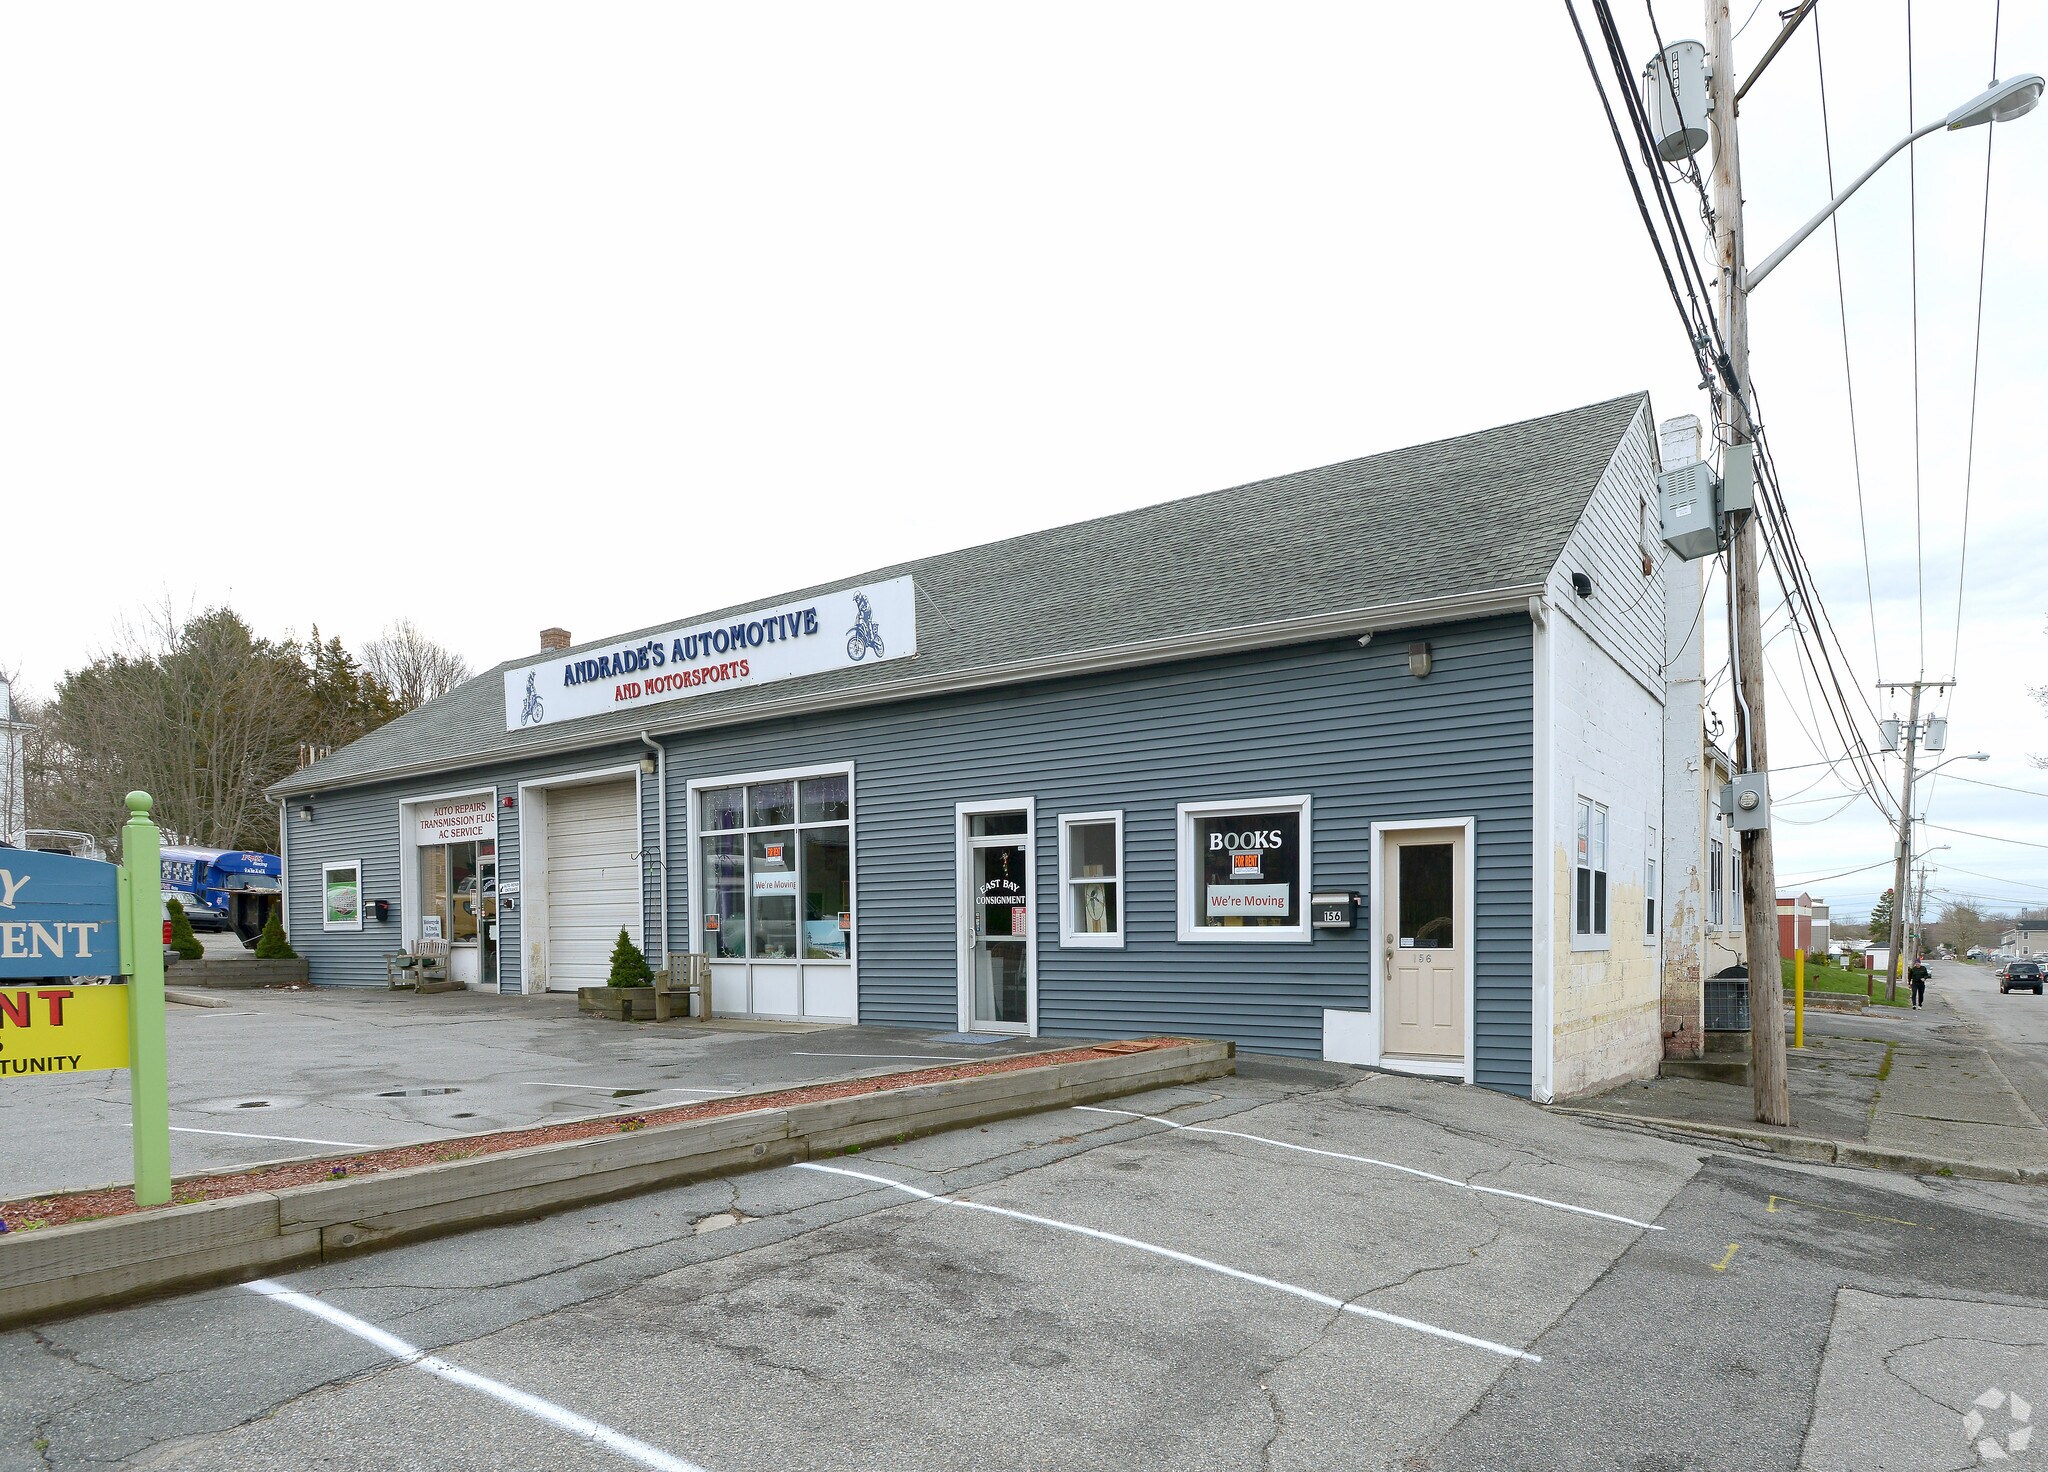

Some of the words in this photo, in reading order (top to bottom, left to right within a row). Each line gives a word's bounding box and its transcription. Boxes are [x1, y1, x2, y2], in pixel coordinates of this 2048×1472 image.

[563, 641, 666, 686] ANDRADE'S
[671, 607, 819, 663] AUTOMOTIVE
[615, 685, 641, 701] AND
[644, 659, 750, 695] MOTORSPORTS
[434, 806, 453, 816] AUTO
[455, 802, 487, 814] REPAIRS
[421, 815, 475, 829] TRANSMISSION
[439, 830, 449, 839] AC
[450, 826, 483, 838] SERVICE
[1210, 830, 1282, 850] BOOKS
[1235, 855, 1244, 867] FOR
[1245, 855, 1257, 867] RENT
[980, 879, 1001, 894] EAST
[1003, 879, 1020, 892] BAY
[976, 895, 1025, 905] CONSIGNMENT
[1211, 896, 1241, 907] We're
[1244, 895, 1284, 909] Moving
[1324, 911, 1341, 922] 156
[0, 922, 98, 958] ENT
[1413, 953, 1432, 963] 156
